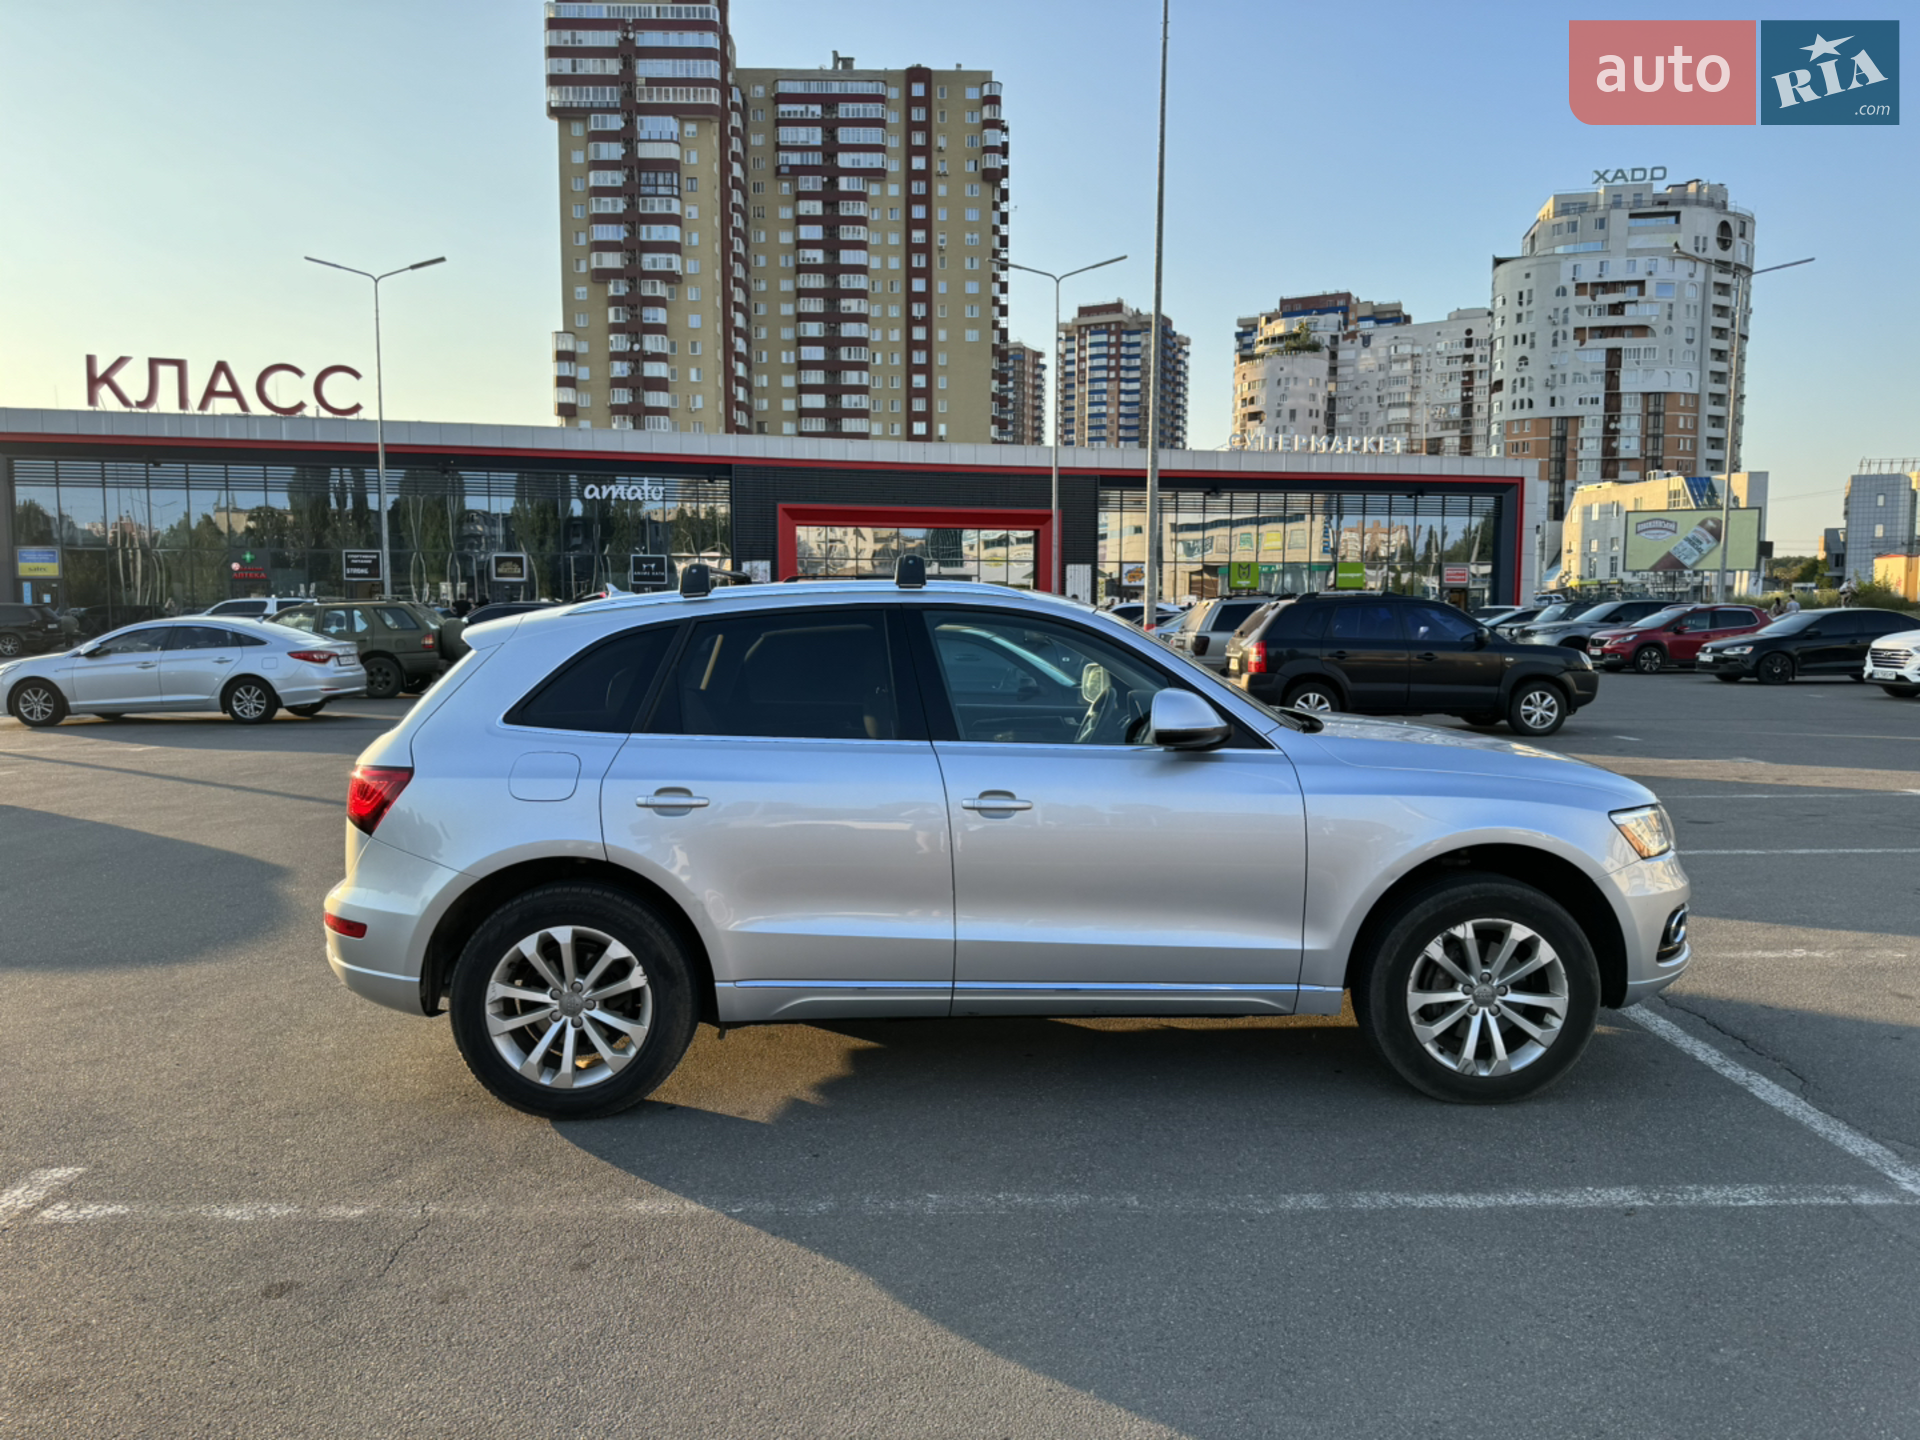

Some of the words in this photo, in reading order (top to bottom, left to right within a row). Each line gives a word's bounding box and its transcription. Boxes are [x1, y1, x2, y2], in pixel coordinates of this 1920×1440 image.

[1592, 166, 1668, 184] XADO
[85, 353, 364, 417] КЛАСС
[1227, 433, 1407, 454] СУПЕРМАРКЕТ
[583, 476, 665, 501] amato
